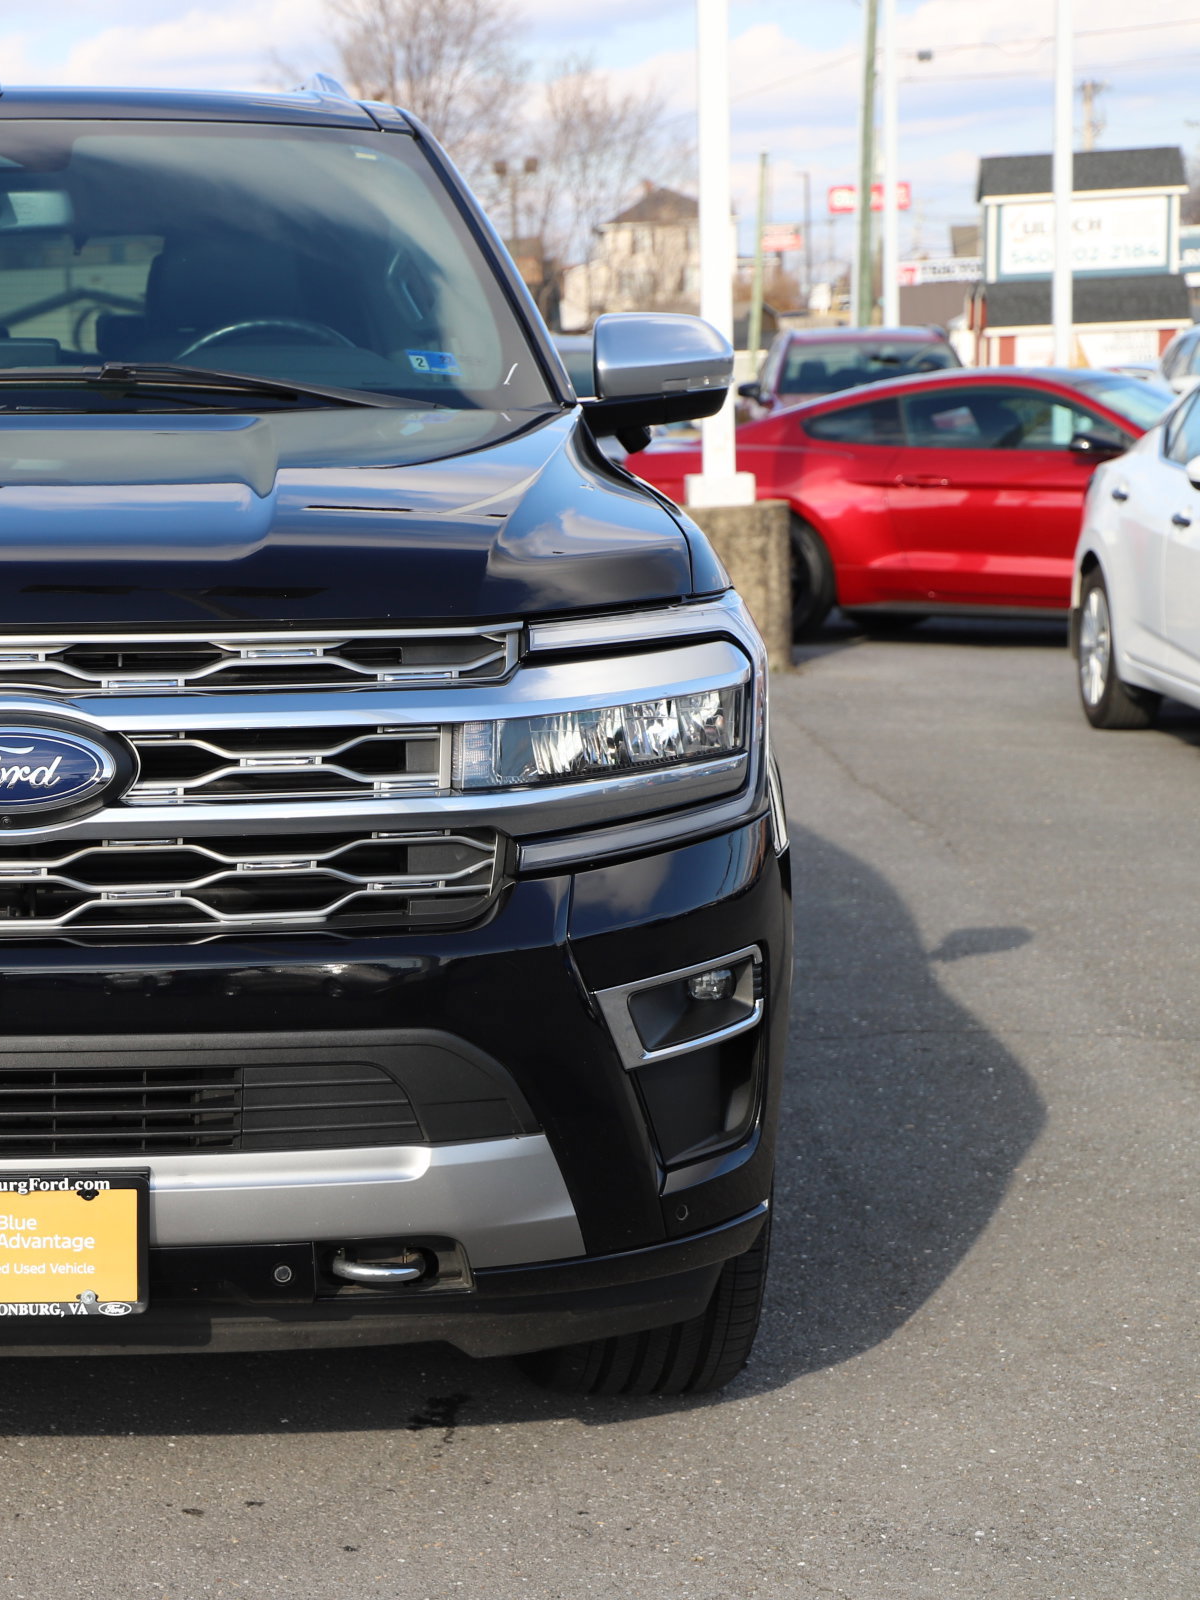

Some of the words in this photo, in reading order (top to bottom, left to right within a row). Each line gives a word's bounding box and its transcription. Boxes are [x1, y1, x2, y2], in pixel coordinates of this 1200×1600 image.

[13, 1264, 46, 1275] Used
[50, 1263, 96, 1275] Vehicle
[69, 1302, 89, 1316] VA
[103, 1304, 127, 1315] Ford
